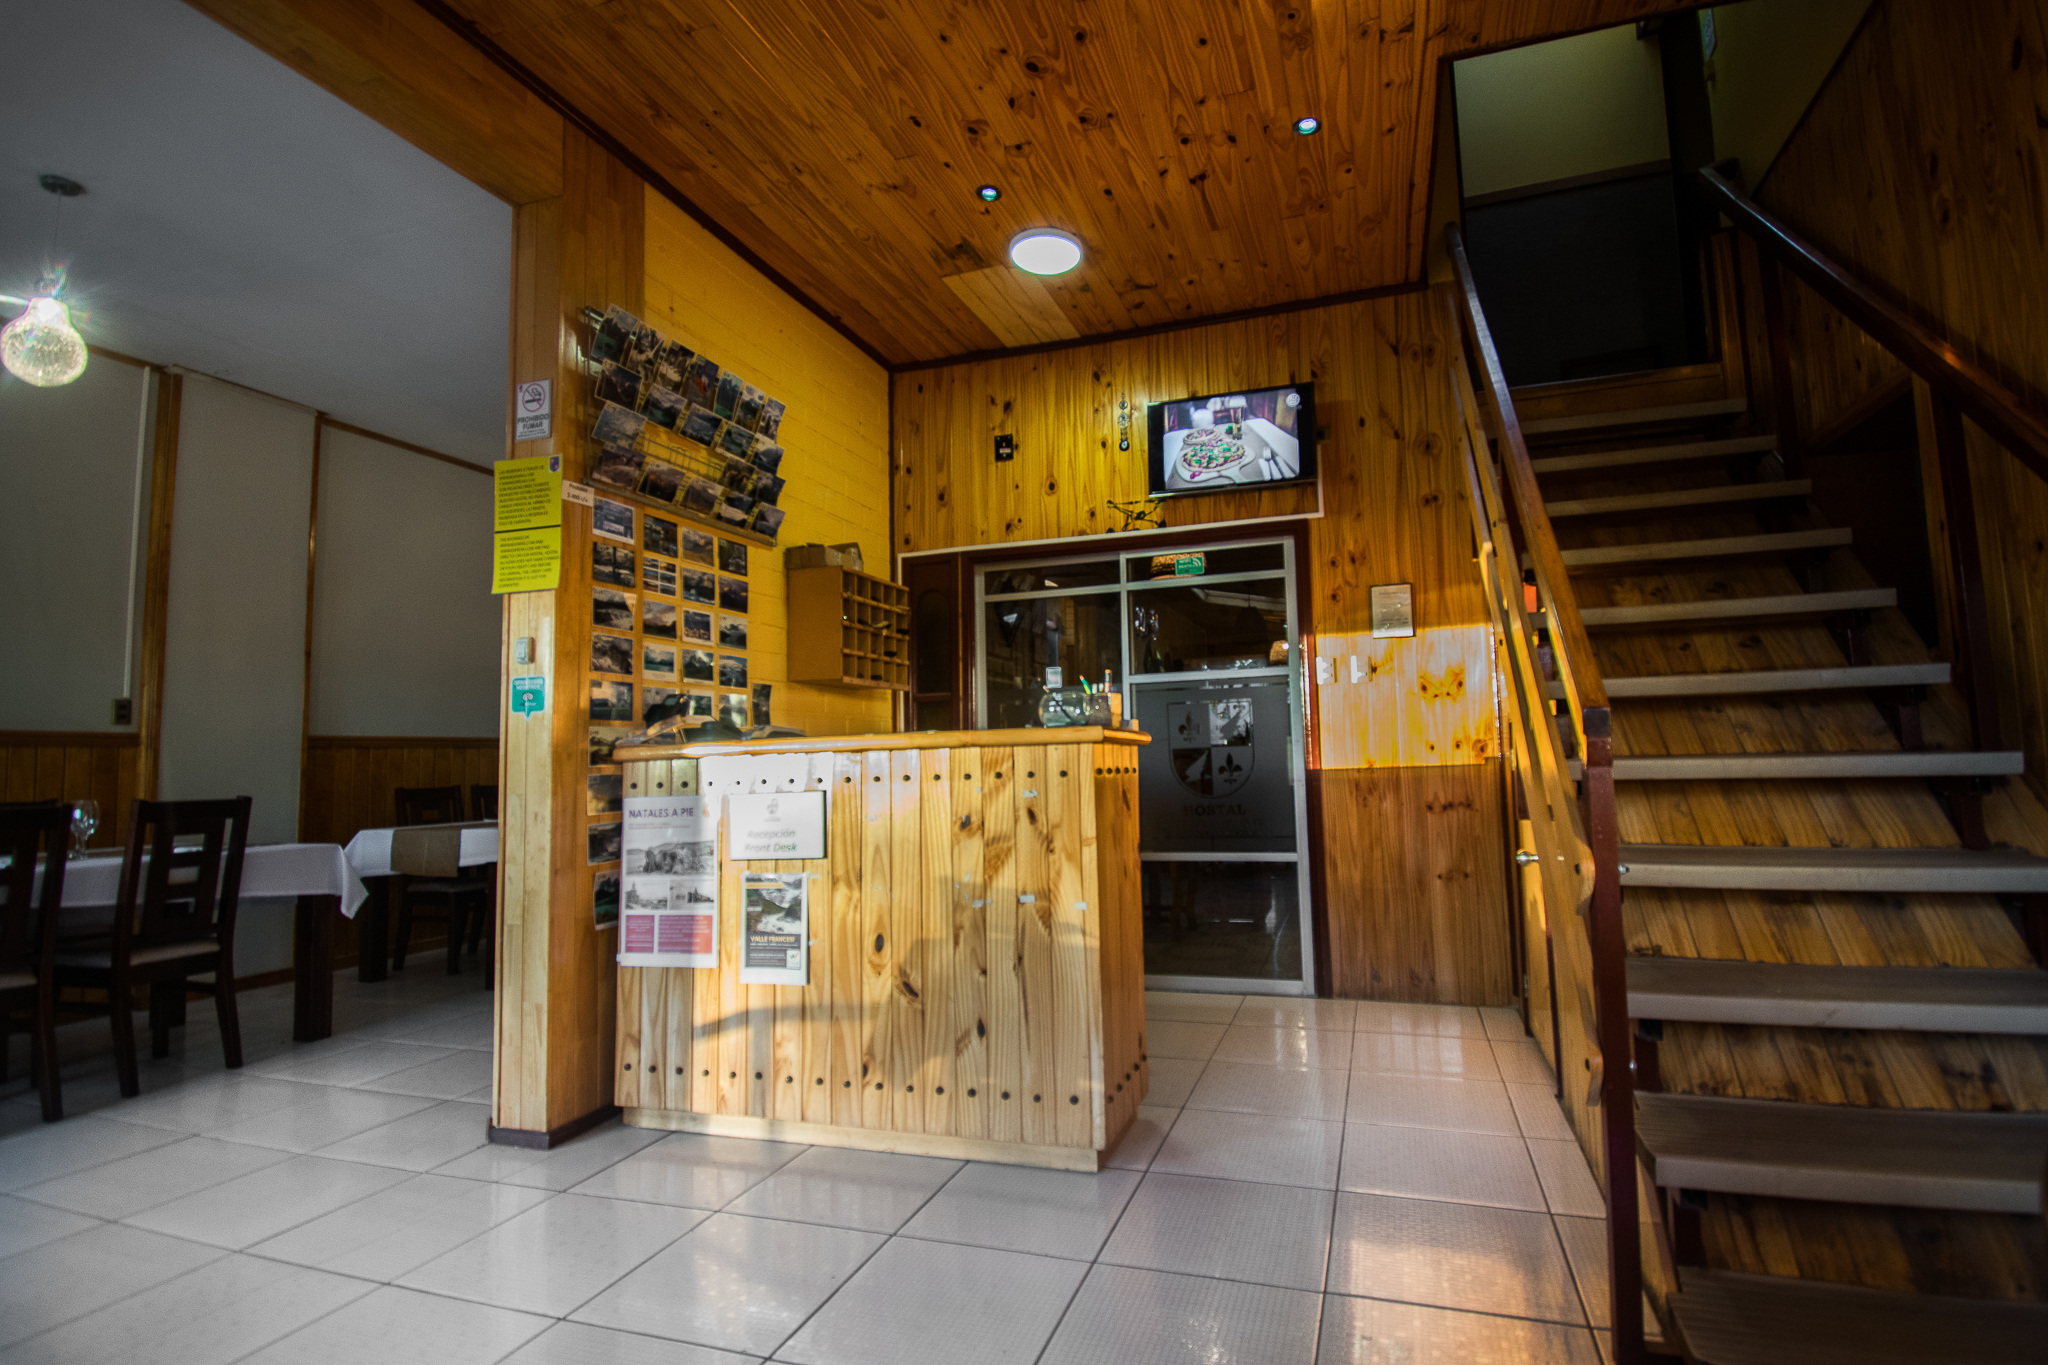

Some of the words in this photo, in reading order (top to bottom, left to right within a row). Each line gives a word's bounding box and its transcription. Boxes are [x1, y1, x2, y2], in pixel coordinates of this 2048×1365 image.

[516, 413, 549, 424] PROHIBIDO
[522, 422, 543, 430] FUMAR
[628, 808, 669, 819] NATALES
[671, 808, 678, 817] A
[680, 807, 694, 817] PIE
[1183, 804, 1247, 816] HOSTAL
[747, 828, 796, 841] Recepción
[744, 843, 770, 853] Front
[773, 842, 797, 852] Desk
[750, 935, 768, 943] VALLE
